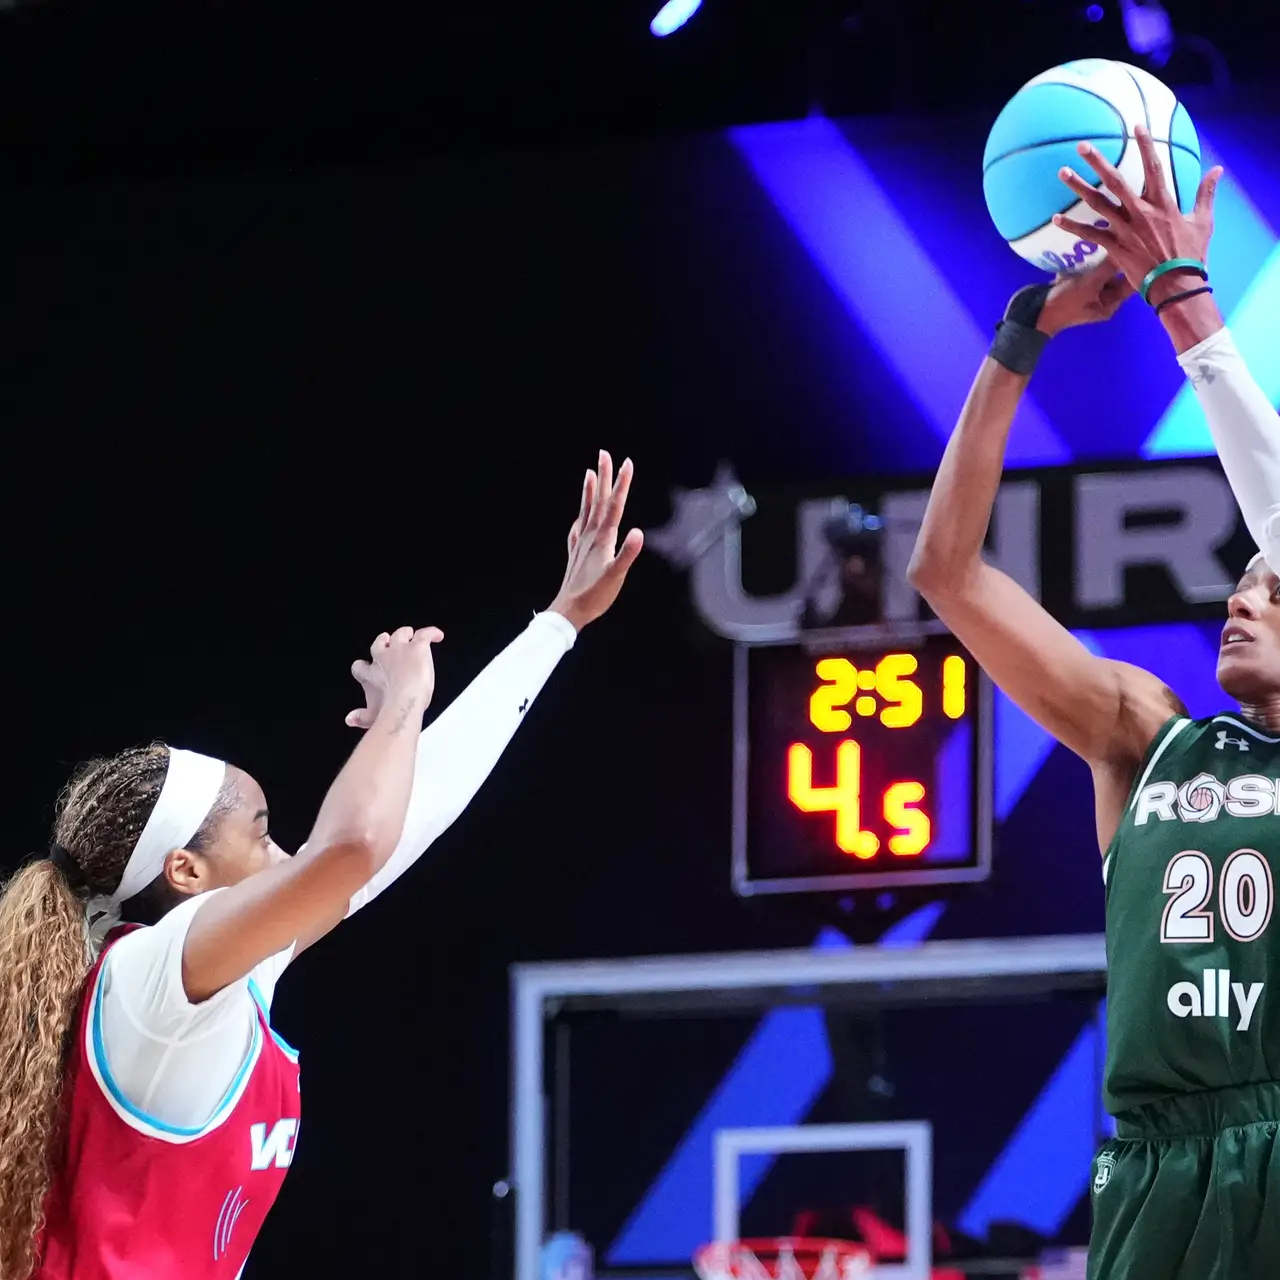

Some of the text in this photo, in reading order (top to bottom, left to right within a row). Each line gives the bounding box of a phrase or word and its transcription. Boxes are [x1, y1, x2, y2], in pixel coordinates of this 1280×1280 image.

[810, 653, 966, 733] 2:51
[1160, 848, 1274, 944] 20
[1167, 968, 1265, 1032] ally
